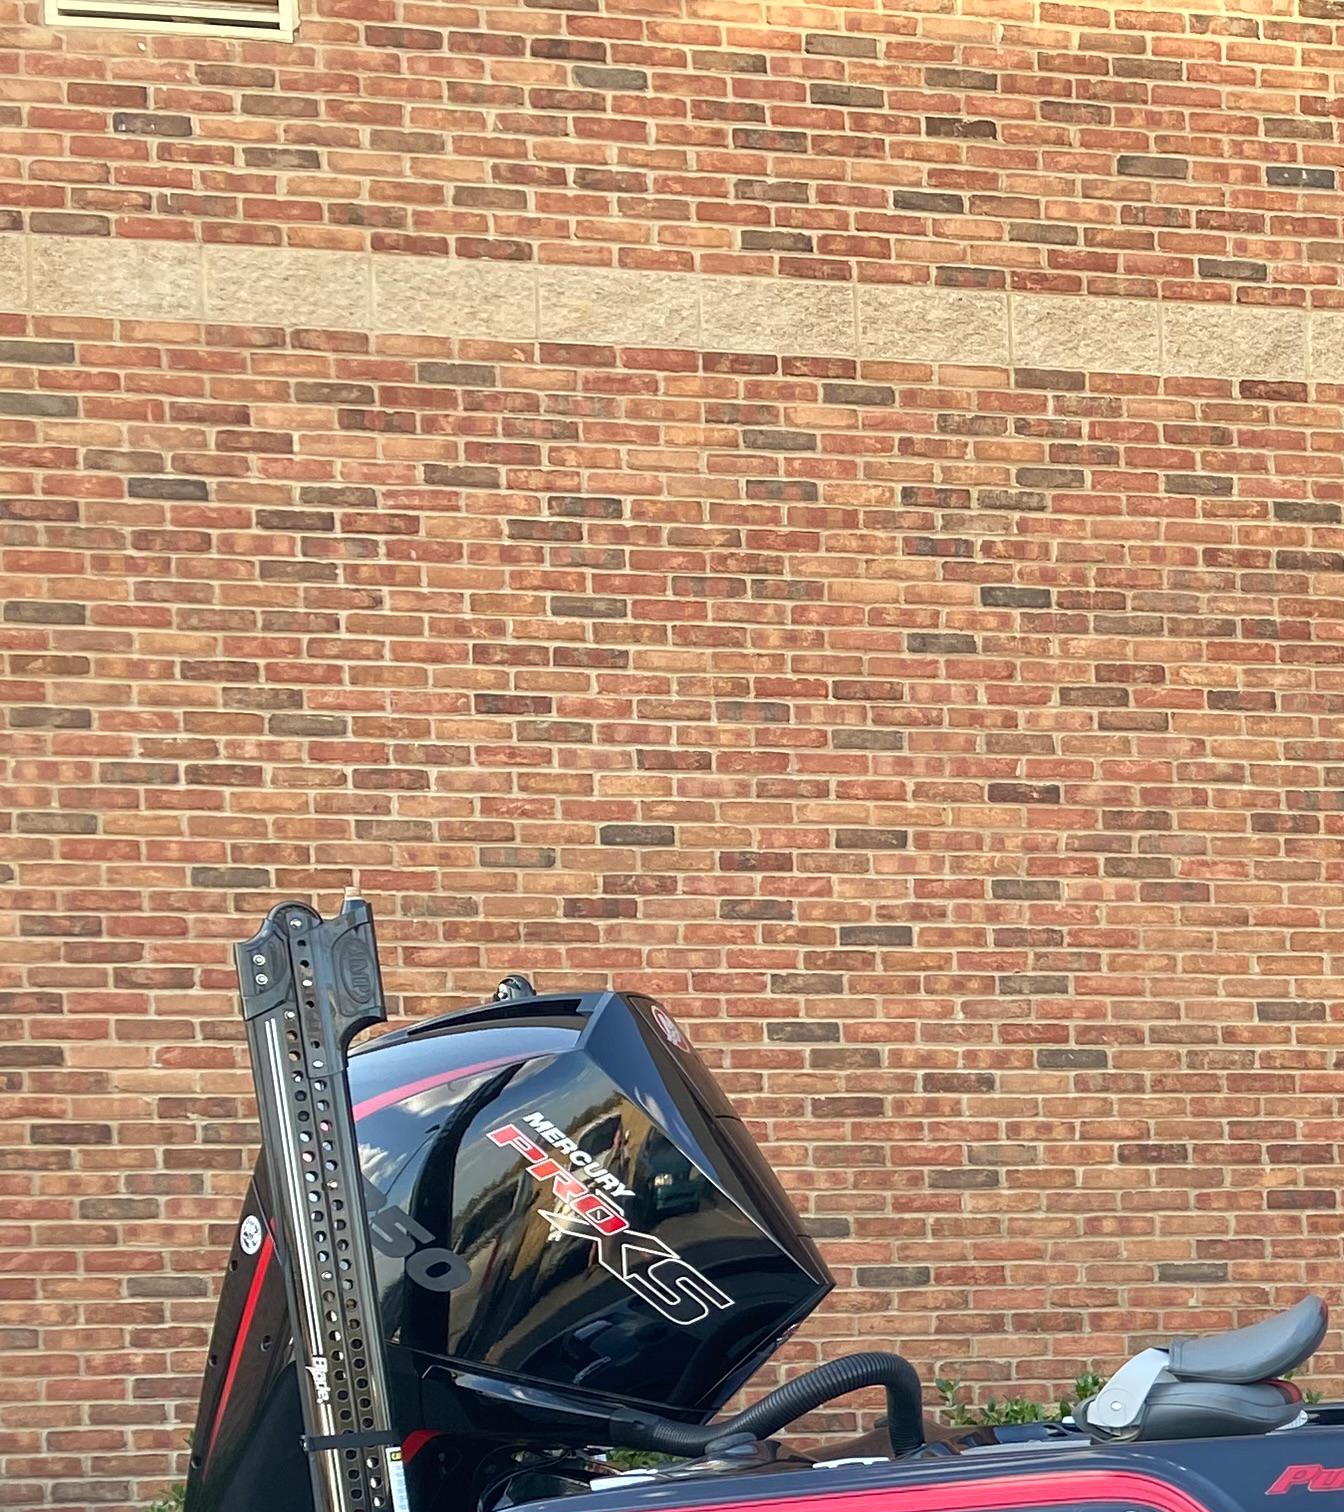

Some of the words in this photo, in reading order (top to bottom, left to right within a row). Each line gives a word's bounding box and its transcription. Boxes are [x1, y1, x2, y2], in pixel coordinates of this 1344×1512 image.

[486, 1124, 630, 1236] PRO
[522, 1112, 635, 1198] MERCURY
[364, 1174, 472, 1292] 50
[537, 1190, 735, 1326] XS
